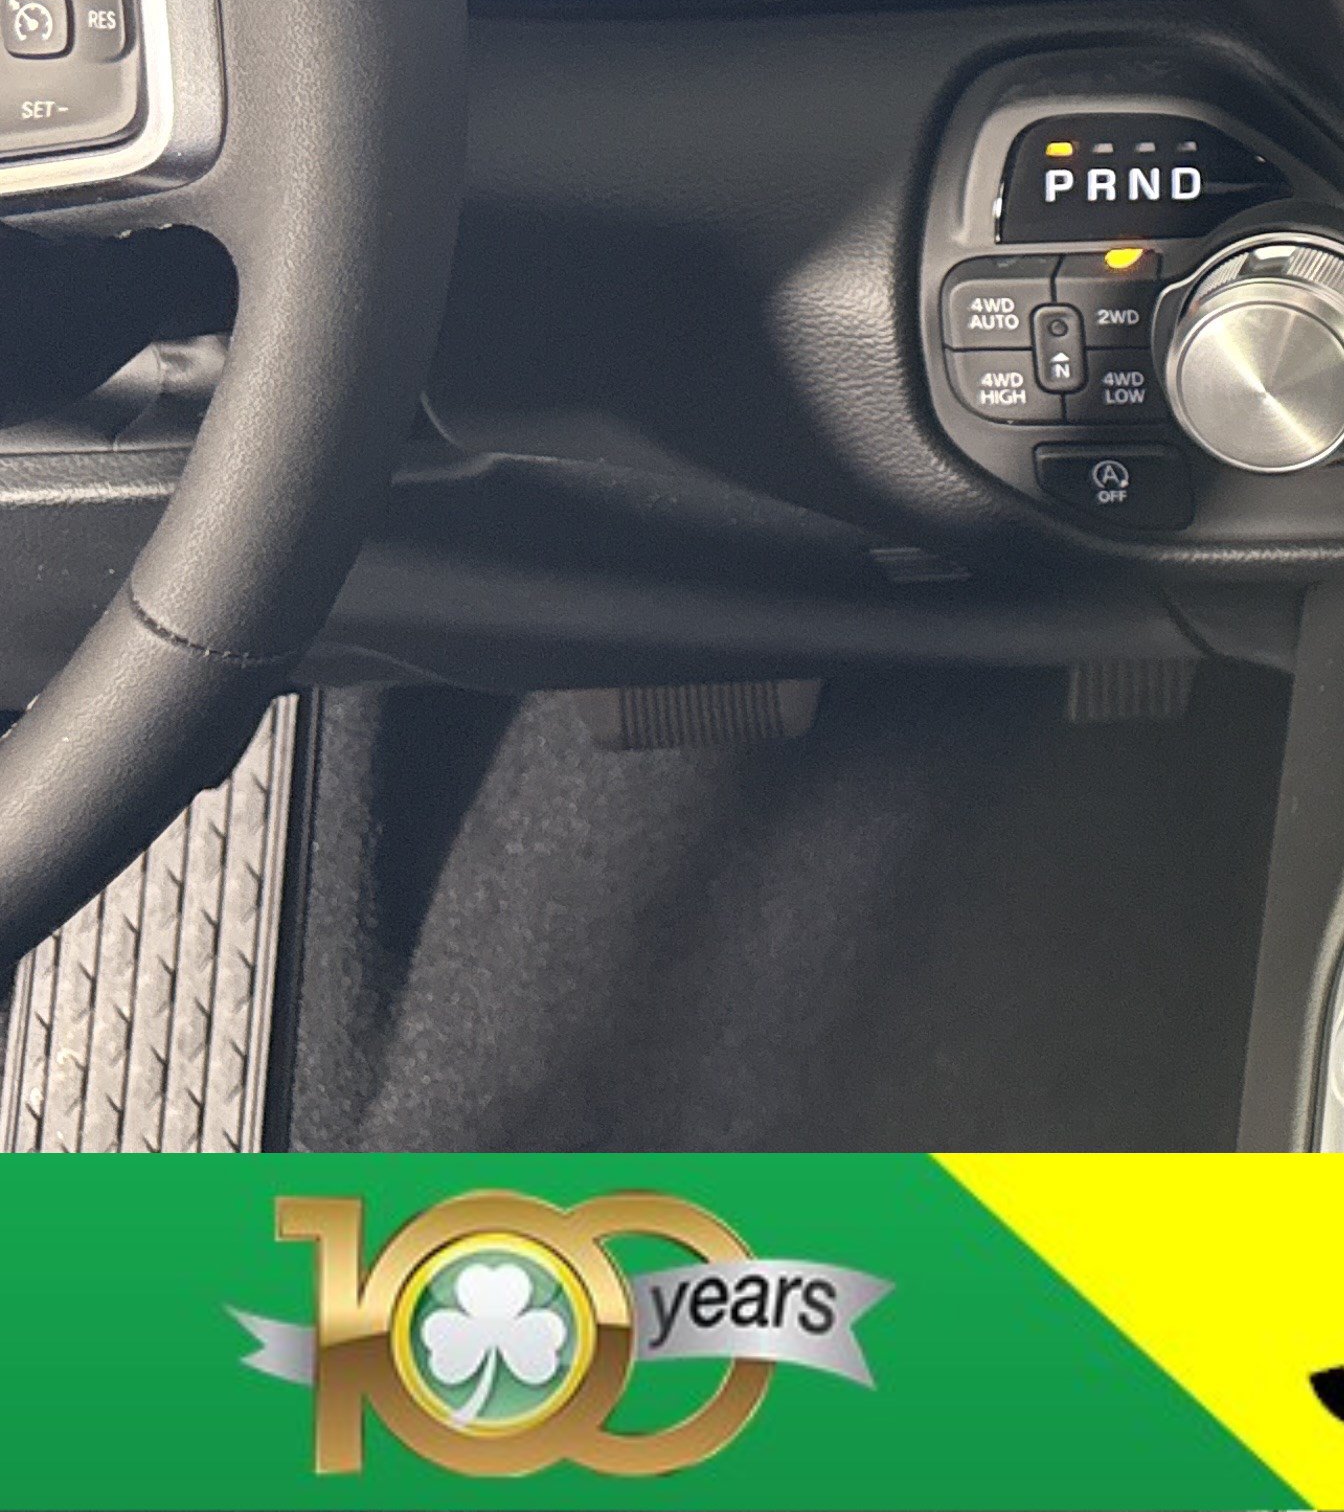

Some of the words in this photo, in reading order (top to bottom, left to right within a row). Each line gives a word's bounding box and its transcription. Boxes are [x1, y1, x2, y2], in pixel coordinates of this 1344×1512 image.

[87, 10, 116, 29] RES
[969, 298, 1015, 313] 4WD
[968, 314, 1019, 330] AUTO
[1098, 309, 1139, 325] 2WD
[1055, 364, 1070, 379] N
[1103, 371, 1144, 387] 4WD
[981, 372, 1023, 388] 4WD
[980, 389, 1026, 405] HIGH
[1105, 389, 1145, 405] LOW
[1098, 491, 1127, 503] OFF
